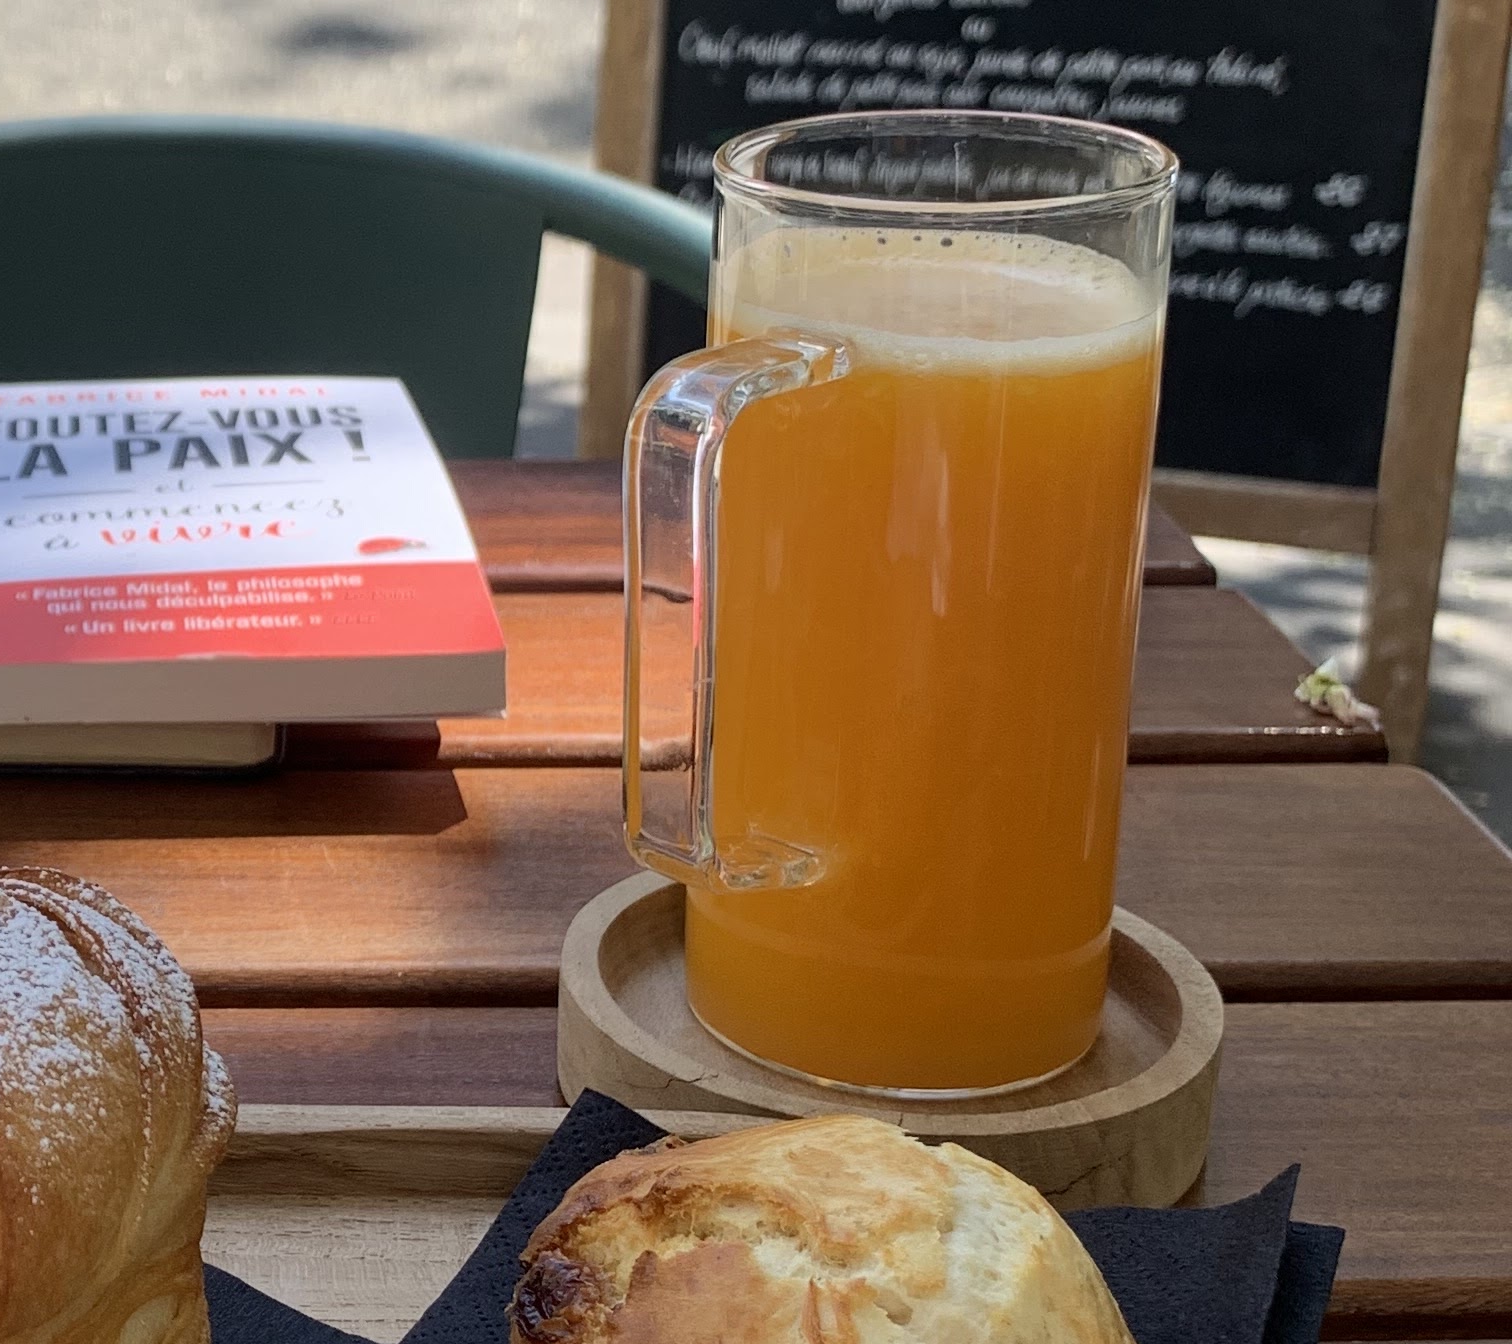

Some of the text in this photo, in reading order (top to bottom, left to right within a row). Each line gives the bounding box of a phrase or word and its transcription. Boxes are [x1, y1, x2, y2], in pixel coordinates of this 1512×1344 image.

[112, 431, 315, 475] PAIX
[32, 583, 117, 602] Fabrice
[207, 577, 229, 594] le
[235, 572, 364, 595] philosophe
[46, 596, 83, 616] qui
[90, 593, 147, 611] nous
[82, 619, 116, 636] Un
[122, 617, 176, 635] livre
